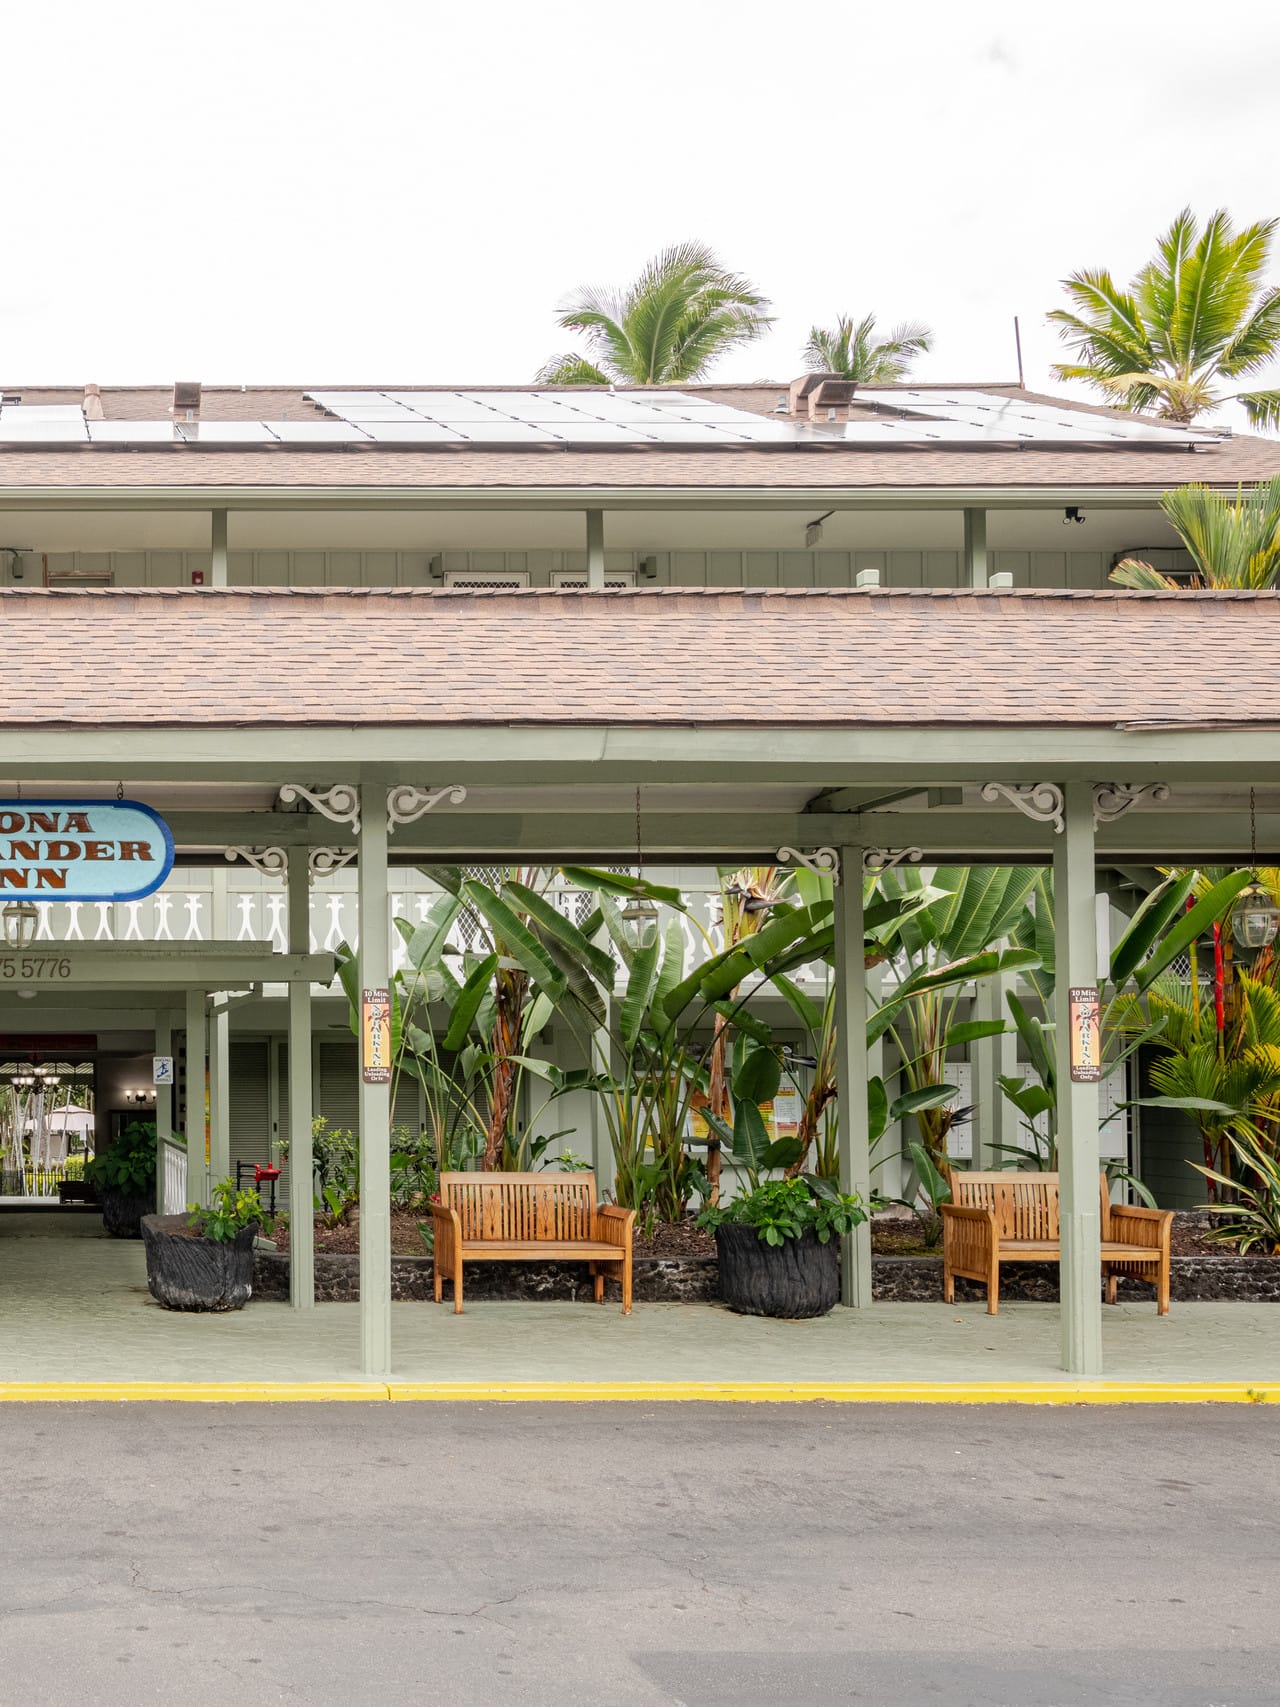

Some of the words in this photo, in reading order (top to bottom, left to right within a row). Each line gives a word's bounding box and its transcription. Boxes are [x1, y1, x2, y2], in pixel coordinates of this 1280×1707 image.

[21, 957, 72, 978] 5776
[371, 1004, 381, 1017] NO
[1080, 1004, 1090, 1016] NO
[372, 1020, 381, 1066] PARKING
[1082, 1020, 1091, 1065] PARKING
